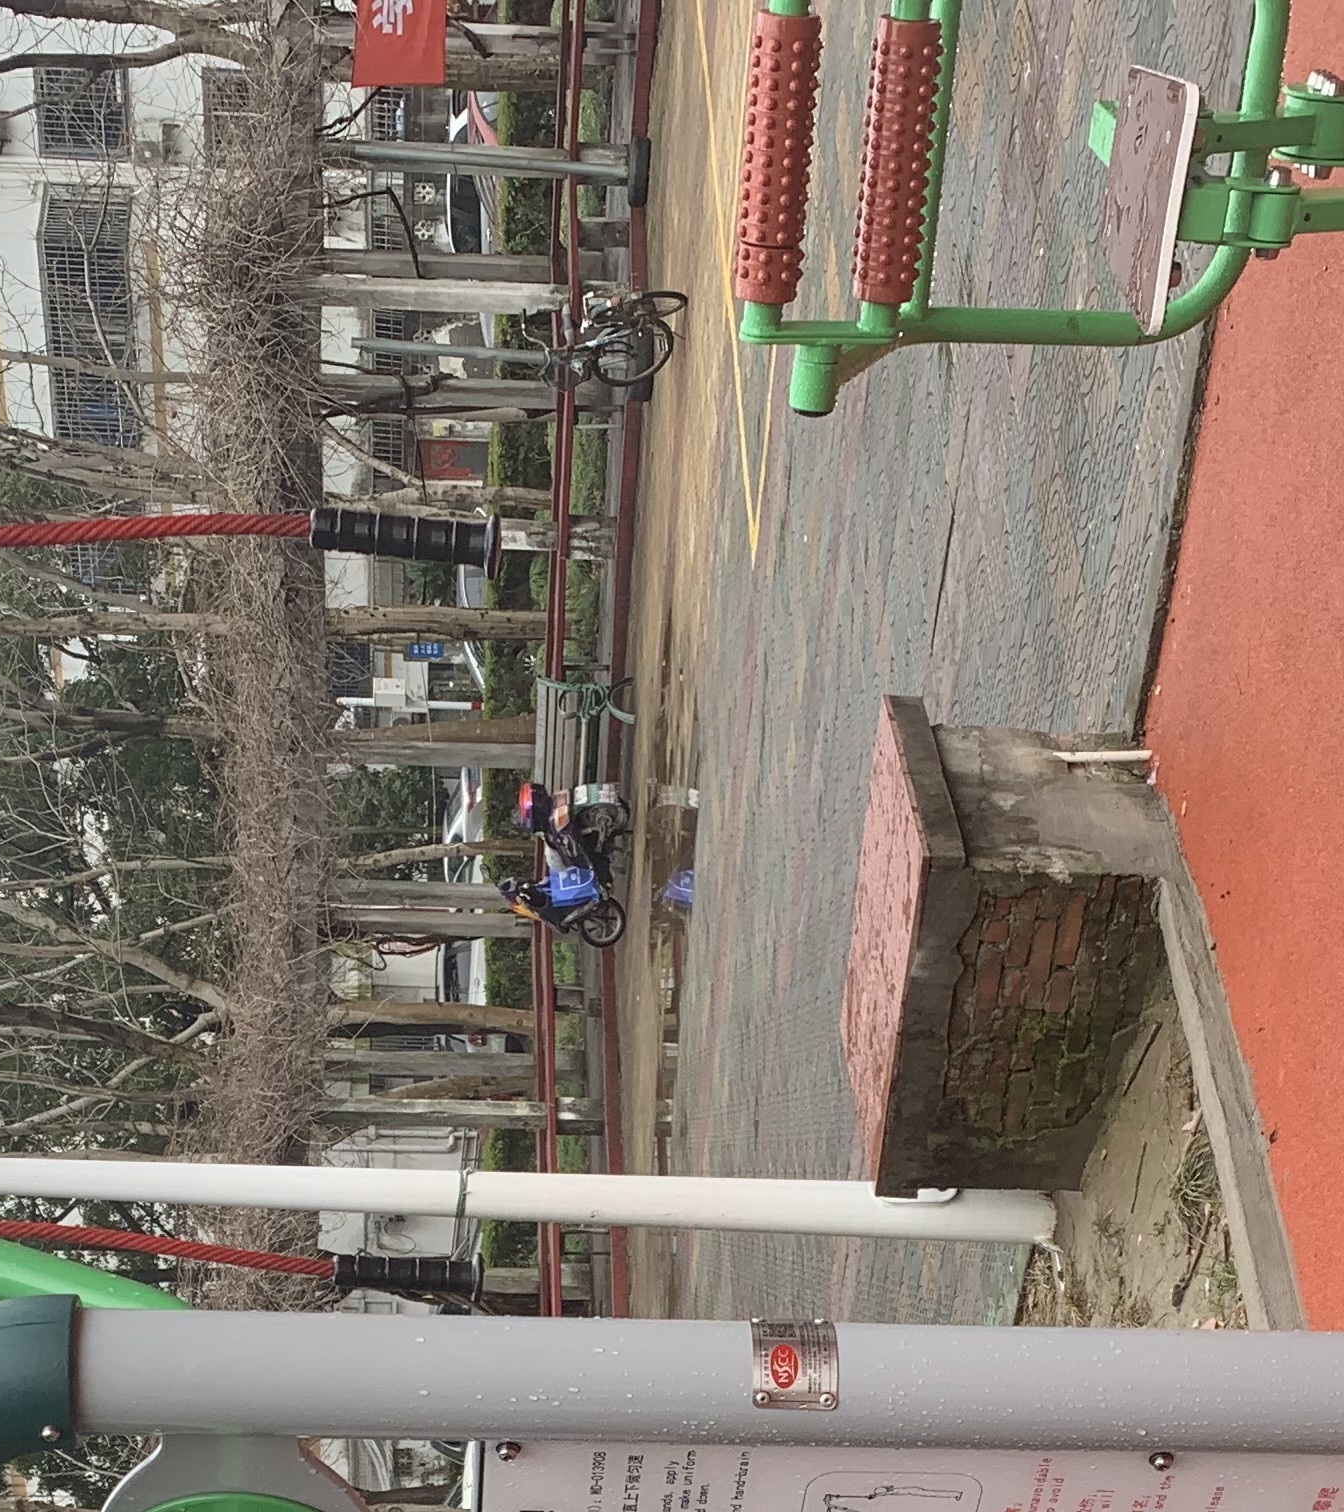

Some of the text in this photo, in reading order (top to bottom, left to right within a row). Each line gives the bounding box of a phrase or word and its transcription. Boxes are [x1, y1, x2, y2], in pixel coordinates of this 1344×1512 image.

[774, 1350, 792, 1383] NSCC
[662, 1461, 680, 1485] apply
[680, 1451, 699, 1486] uniform
[1045, 1478, 1065, 1504] avoid
[1157, 1475, 1177, 1490] the
[677, 1490, 693, 1510] make
[1150, 1495, 1170, 1510] and
